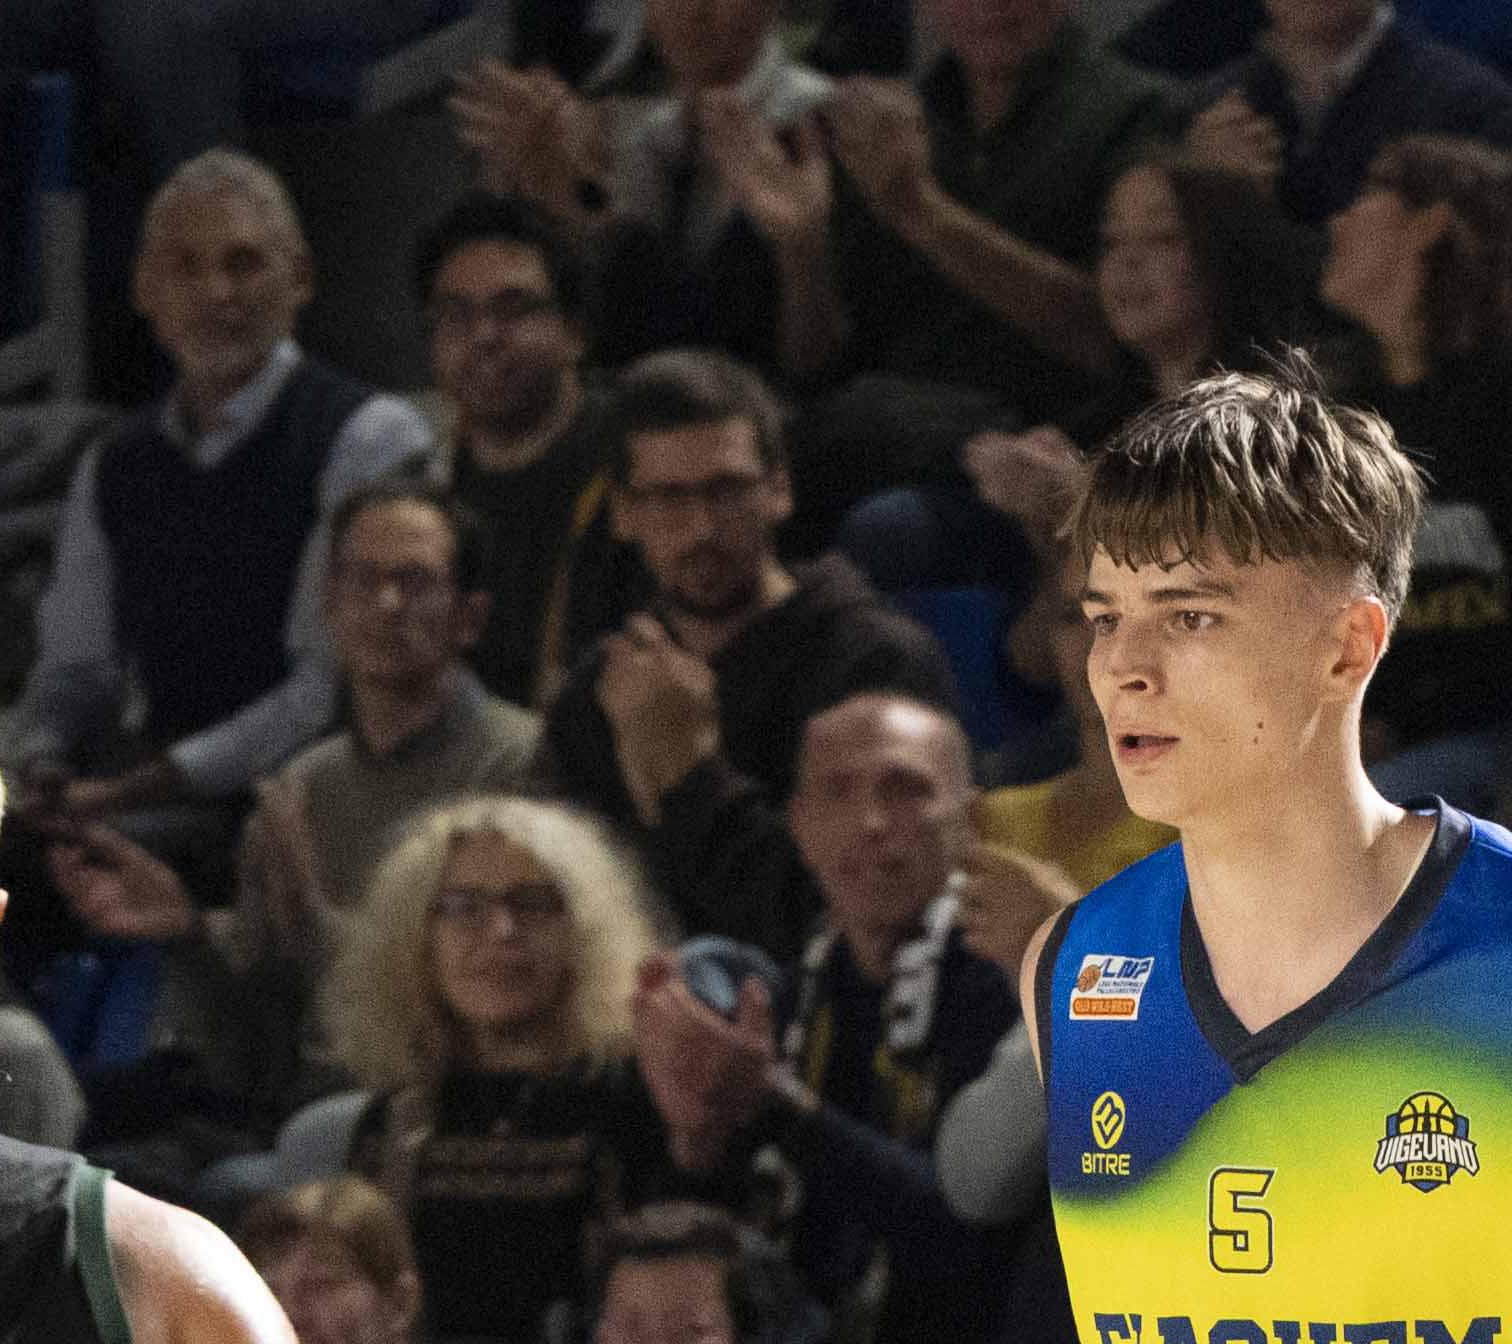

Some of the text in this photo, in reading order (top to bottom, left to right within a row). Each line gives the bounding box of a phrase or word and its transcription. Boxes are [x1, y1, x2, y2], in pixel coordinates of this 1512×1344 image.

[1081, 1151, 1131, 1176] BITRE
[1376, 1132, 1478, 1173] VIGEVANO
[1409, 1164, 1443, 1178] 1955
[1208, 1166, 1277, 1275] 5
